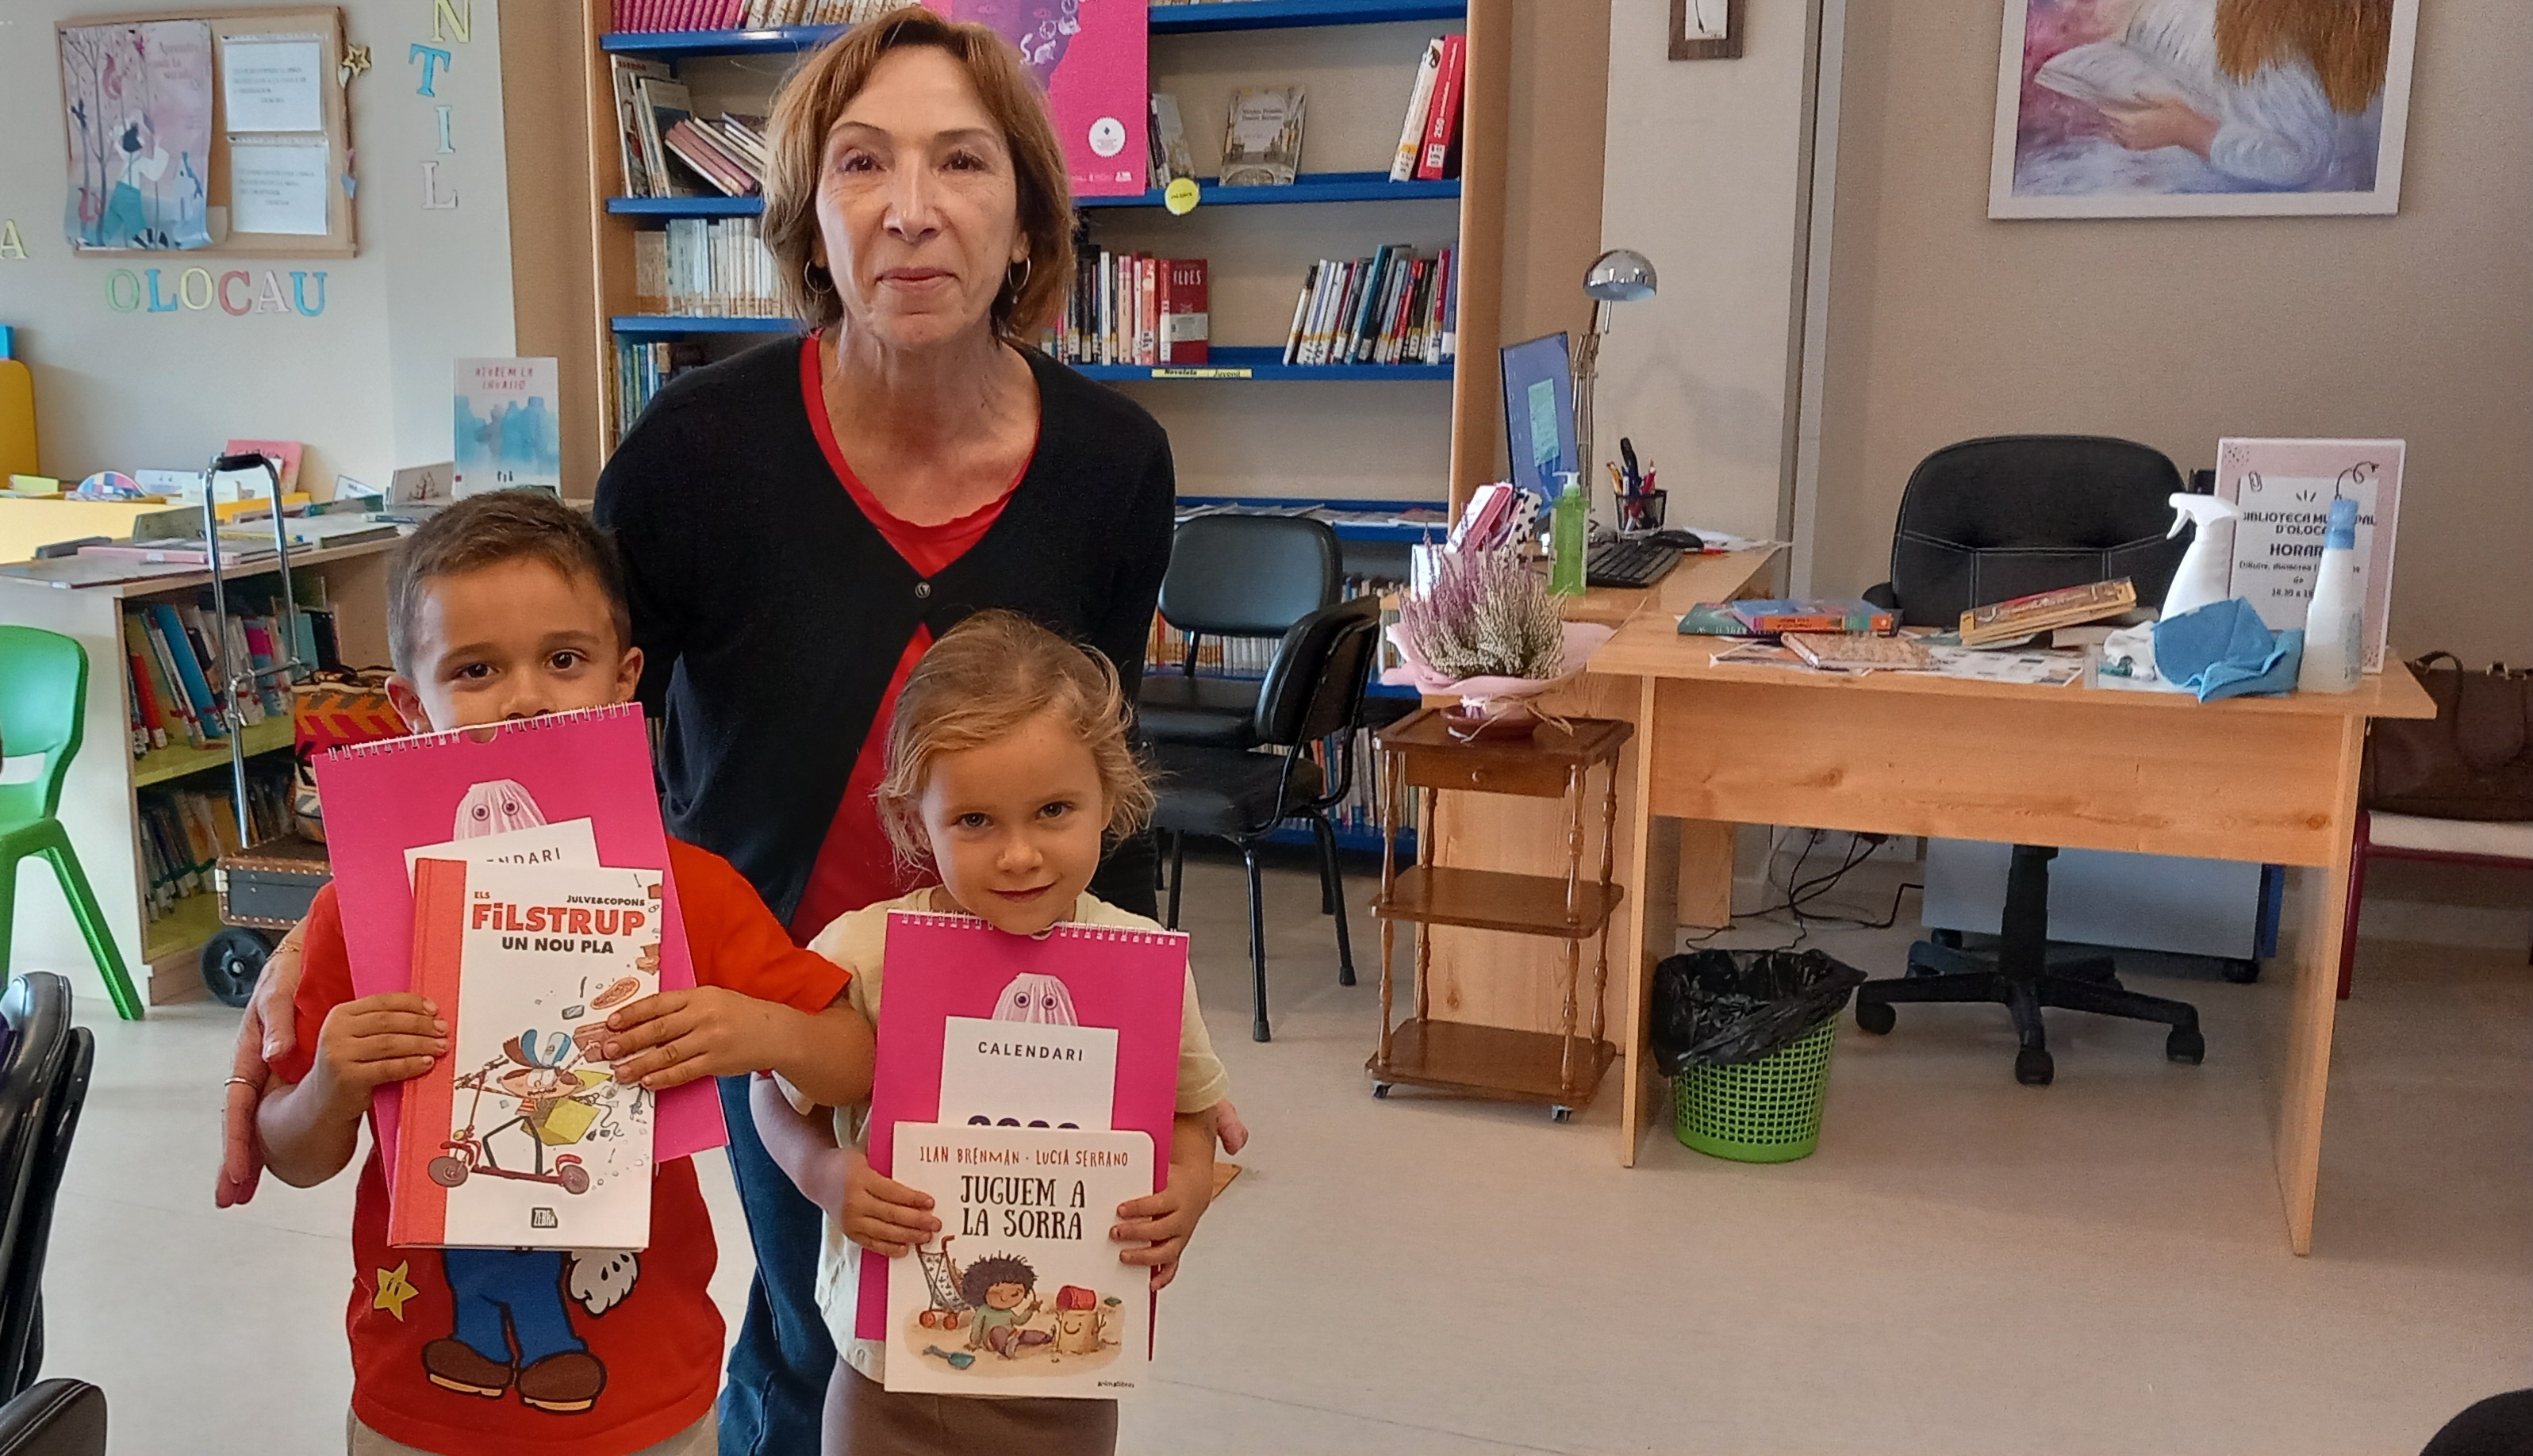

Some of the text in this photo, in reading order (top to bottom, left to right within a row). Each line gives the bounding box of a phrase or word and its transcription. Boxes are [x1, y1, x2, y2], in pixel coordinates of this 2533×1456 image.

[106, 267, 328, 316] OLOCAU
[2275, 523, 2327, 536] D'OLOC
[2270, 543, 2324, 557] HORAR
[486, 847, 561, 864] NDARI
[566, 895, 646, 906] JULVE&COPONS
[502, 937, 614, 953] UN NOU PLA
[978, 1041, 1084, 1062] CALENDARI
[919, 1146, 949, 1163] ILAN
[958, 1148, 1019, 1166] BRENMAN
[1075, 1150, 1128, 1167] SERRANO
[961, 1175, 1085, 1208] JUGUEM A
[961, 1208, 1082, 1240] LA SORRA
